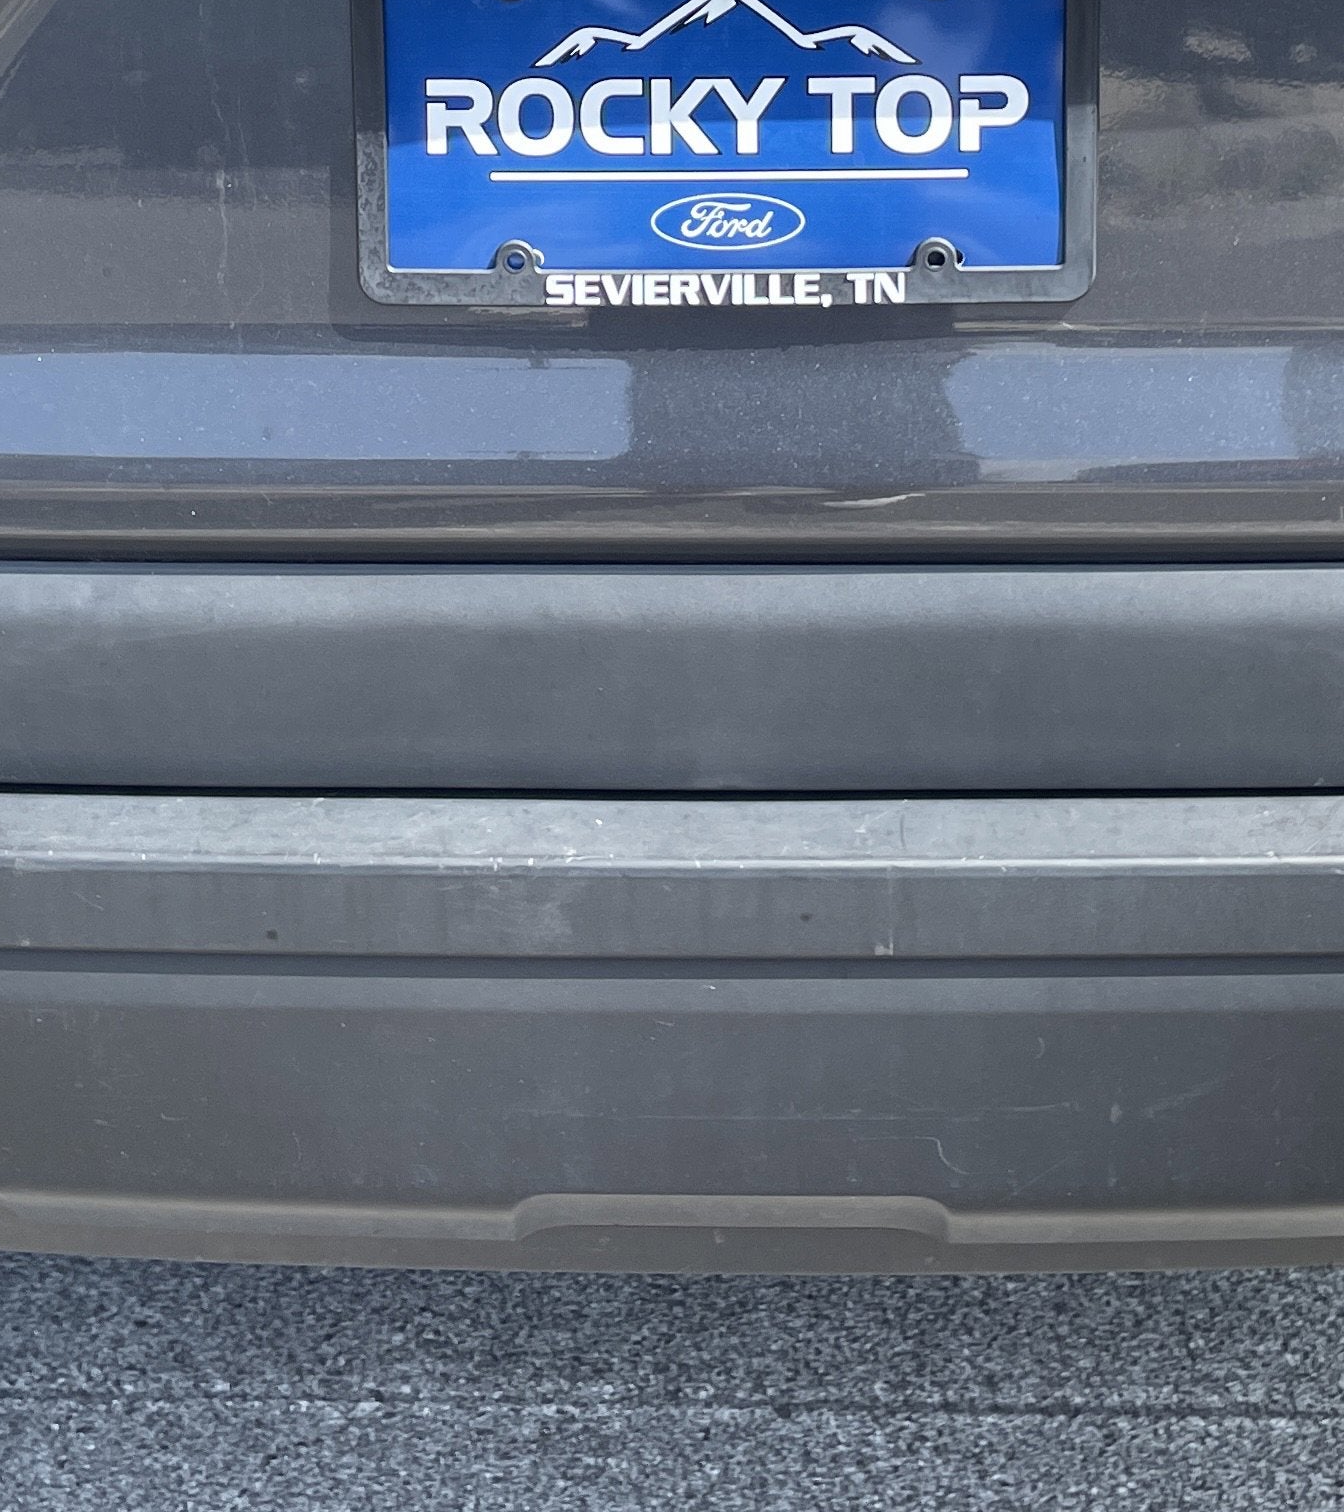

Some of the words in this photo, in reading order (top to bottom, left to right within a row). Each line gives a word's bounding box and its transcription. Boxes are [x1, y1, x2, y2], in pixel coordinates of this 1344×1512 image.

[425, 77, 785, 156] ROCKY
[807, 75, 1029, 154] TOP
[680, 201, 773, 240] Ford
[544, 272, 832, 308] SEVIERVILLE,
[845, 271, 906, 304] TN
